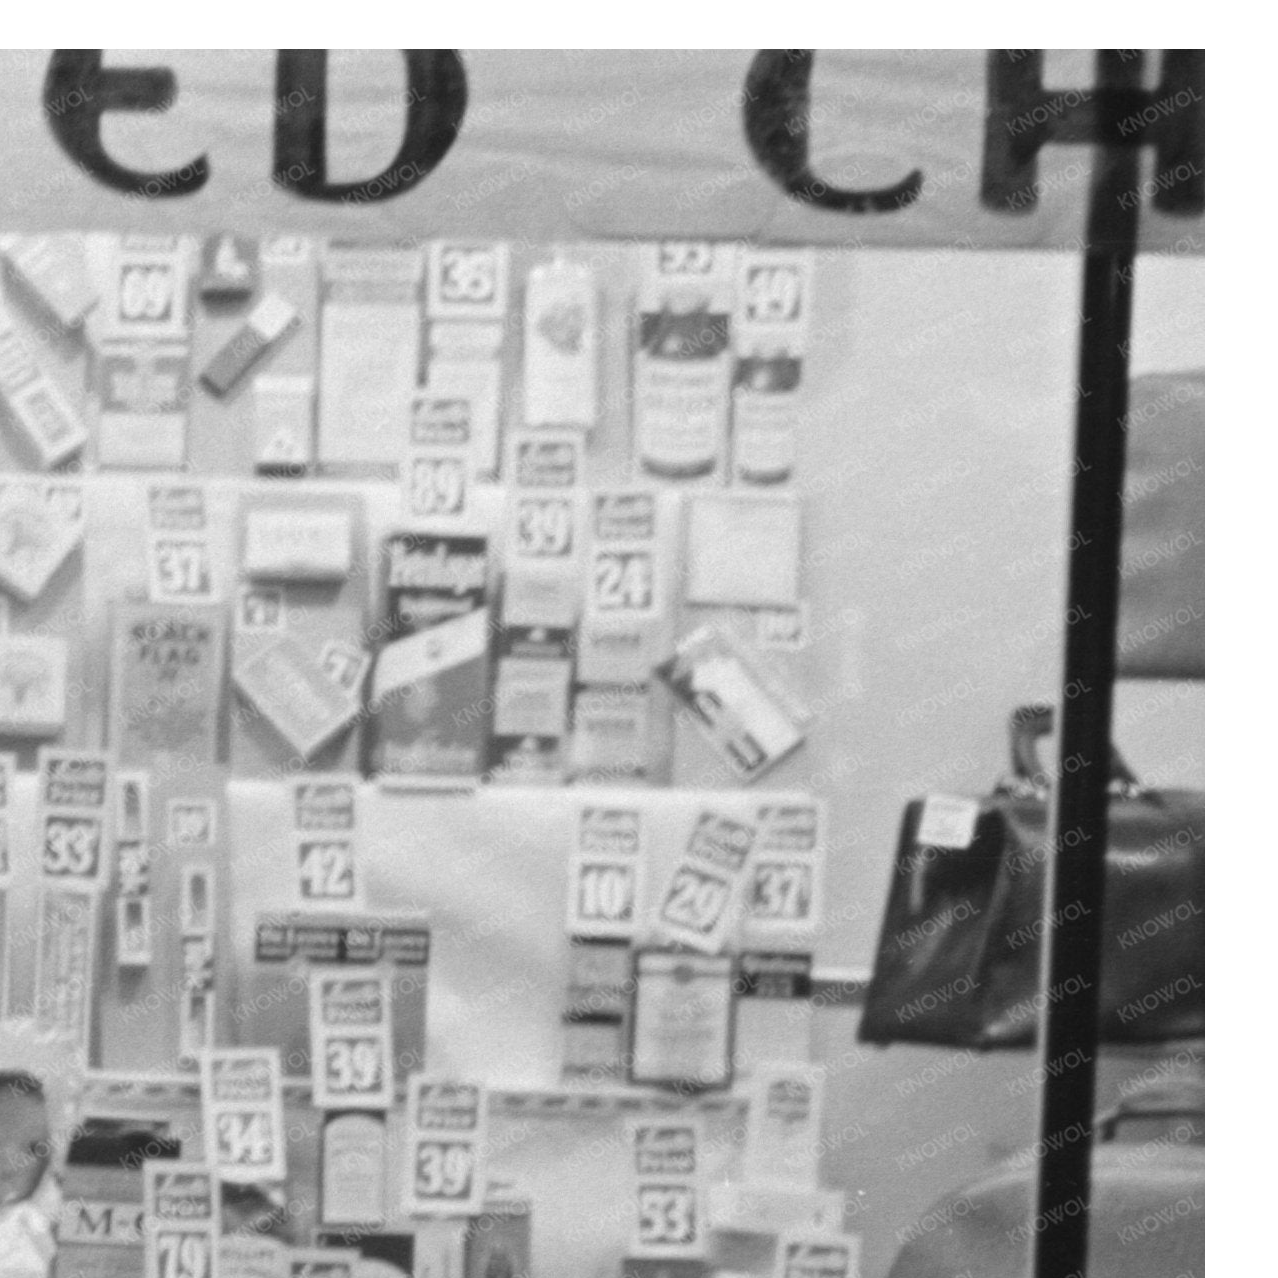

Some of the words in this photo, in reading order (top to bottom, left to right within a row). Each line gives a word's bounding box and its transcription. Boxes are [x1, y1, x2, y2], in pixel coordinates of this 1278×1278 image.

[45, 822, 95, 875] 33
[327, 1041, 382, 1089] 39
[416, 1145, 473, 1196] 39
[640, 1189, 694, 1243] 53
